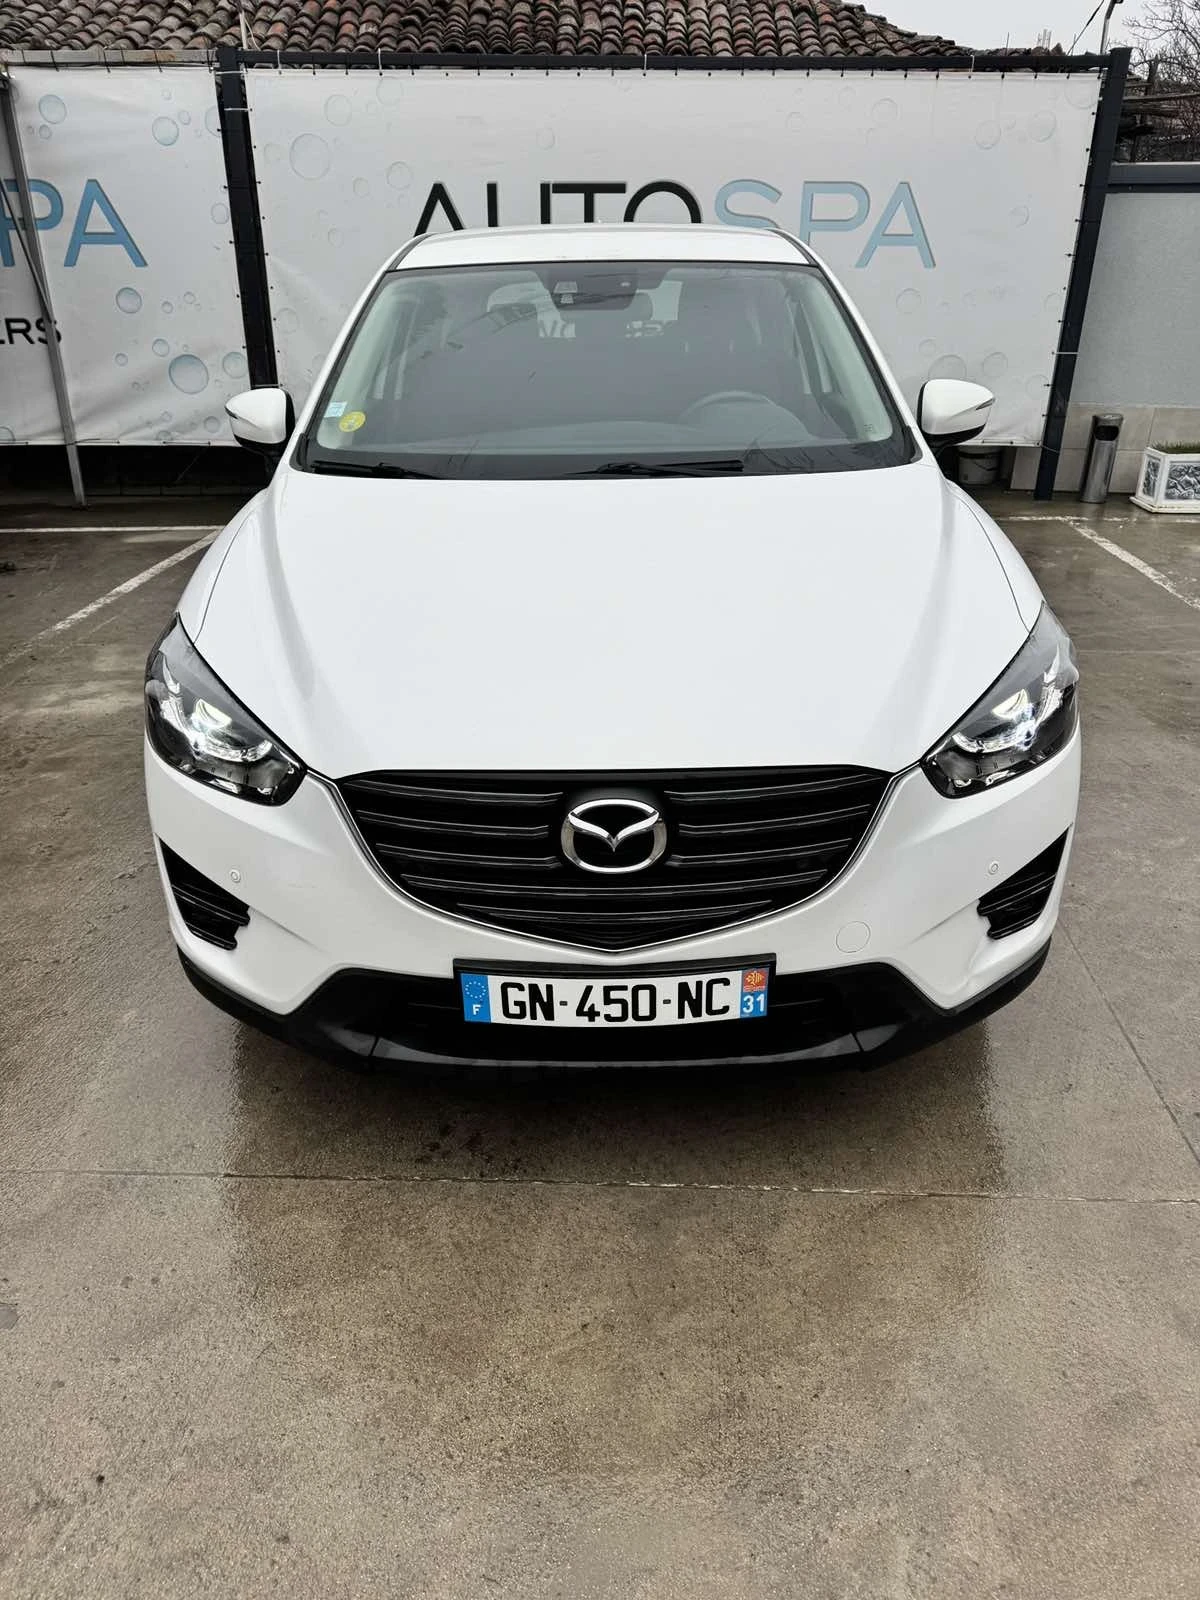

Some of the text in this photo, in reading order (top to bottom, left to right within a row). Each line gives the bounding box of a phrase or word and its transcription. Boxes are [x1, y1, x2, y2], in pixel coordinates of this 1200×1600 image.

[0, 317, 62, 345] RS
[472, 1004, 481, 1016] F
[499, 977, 731, 1023] GN-450-NC
[742, 993, 765, 1013] 31
